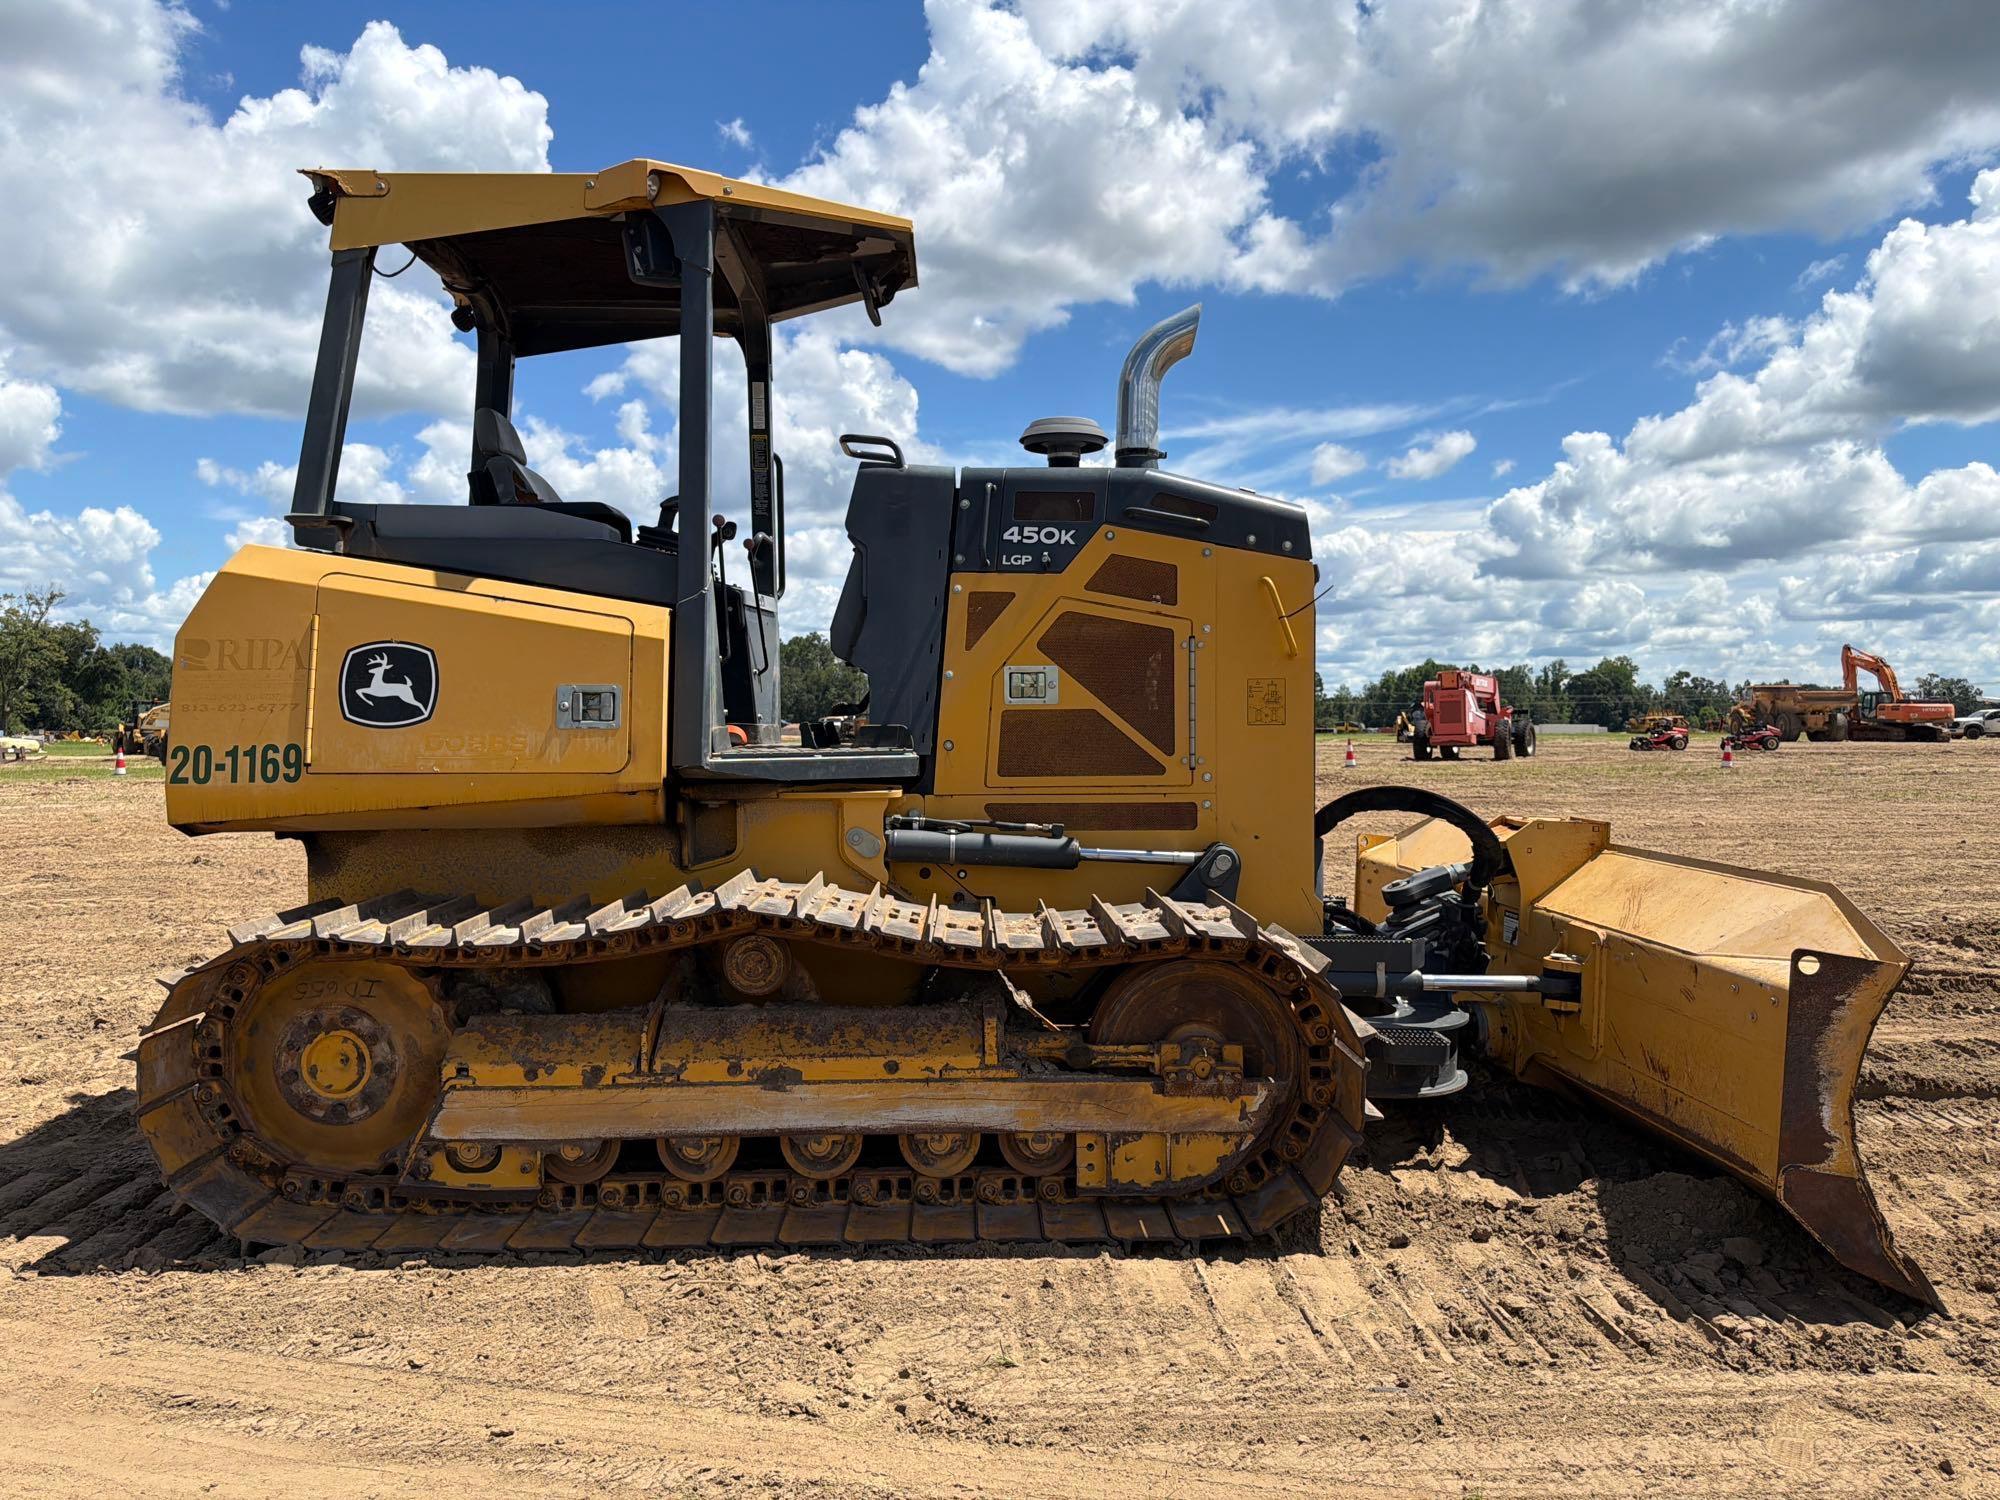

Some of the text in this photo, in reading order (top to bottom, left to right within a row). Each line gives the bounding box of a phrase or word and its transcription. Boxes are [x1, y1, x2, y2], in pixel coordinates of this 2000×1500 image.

[1002, 526, 1076, 545] 450K
[1002, 554, 1033, 566] LGP
[215, 637, 309, 671] RIPA
[169, 743, 302, 785] 20-1169
